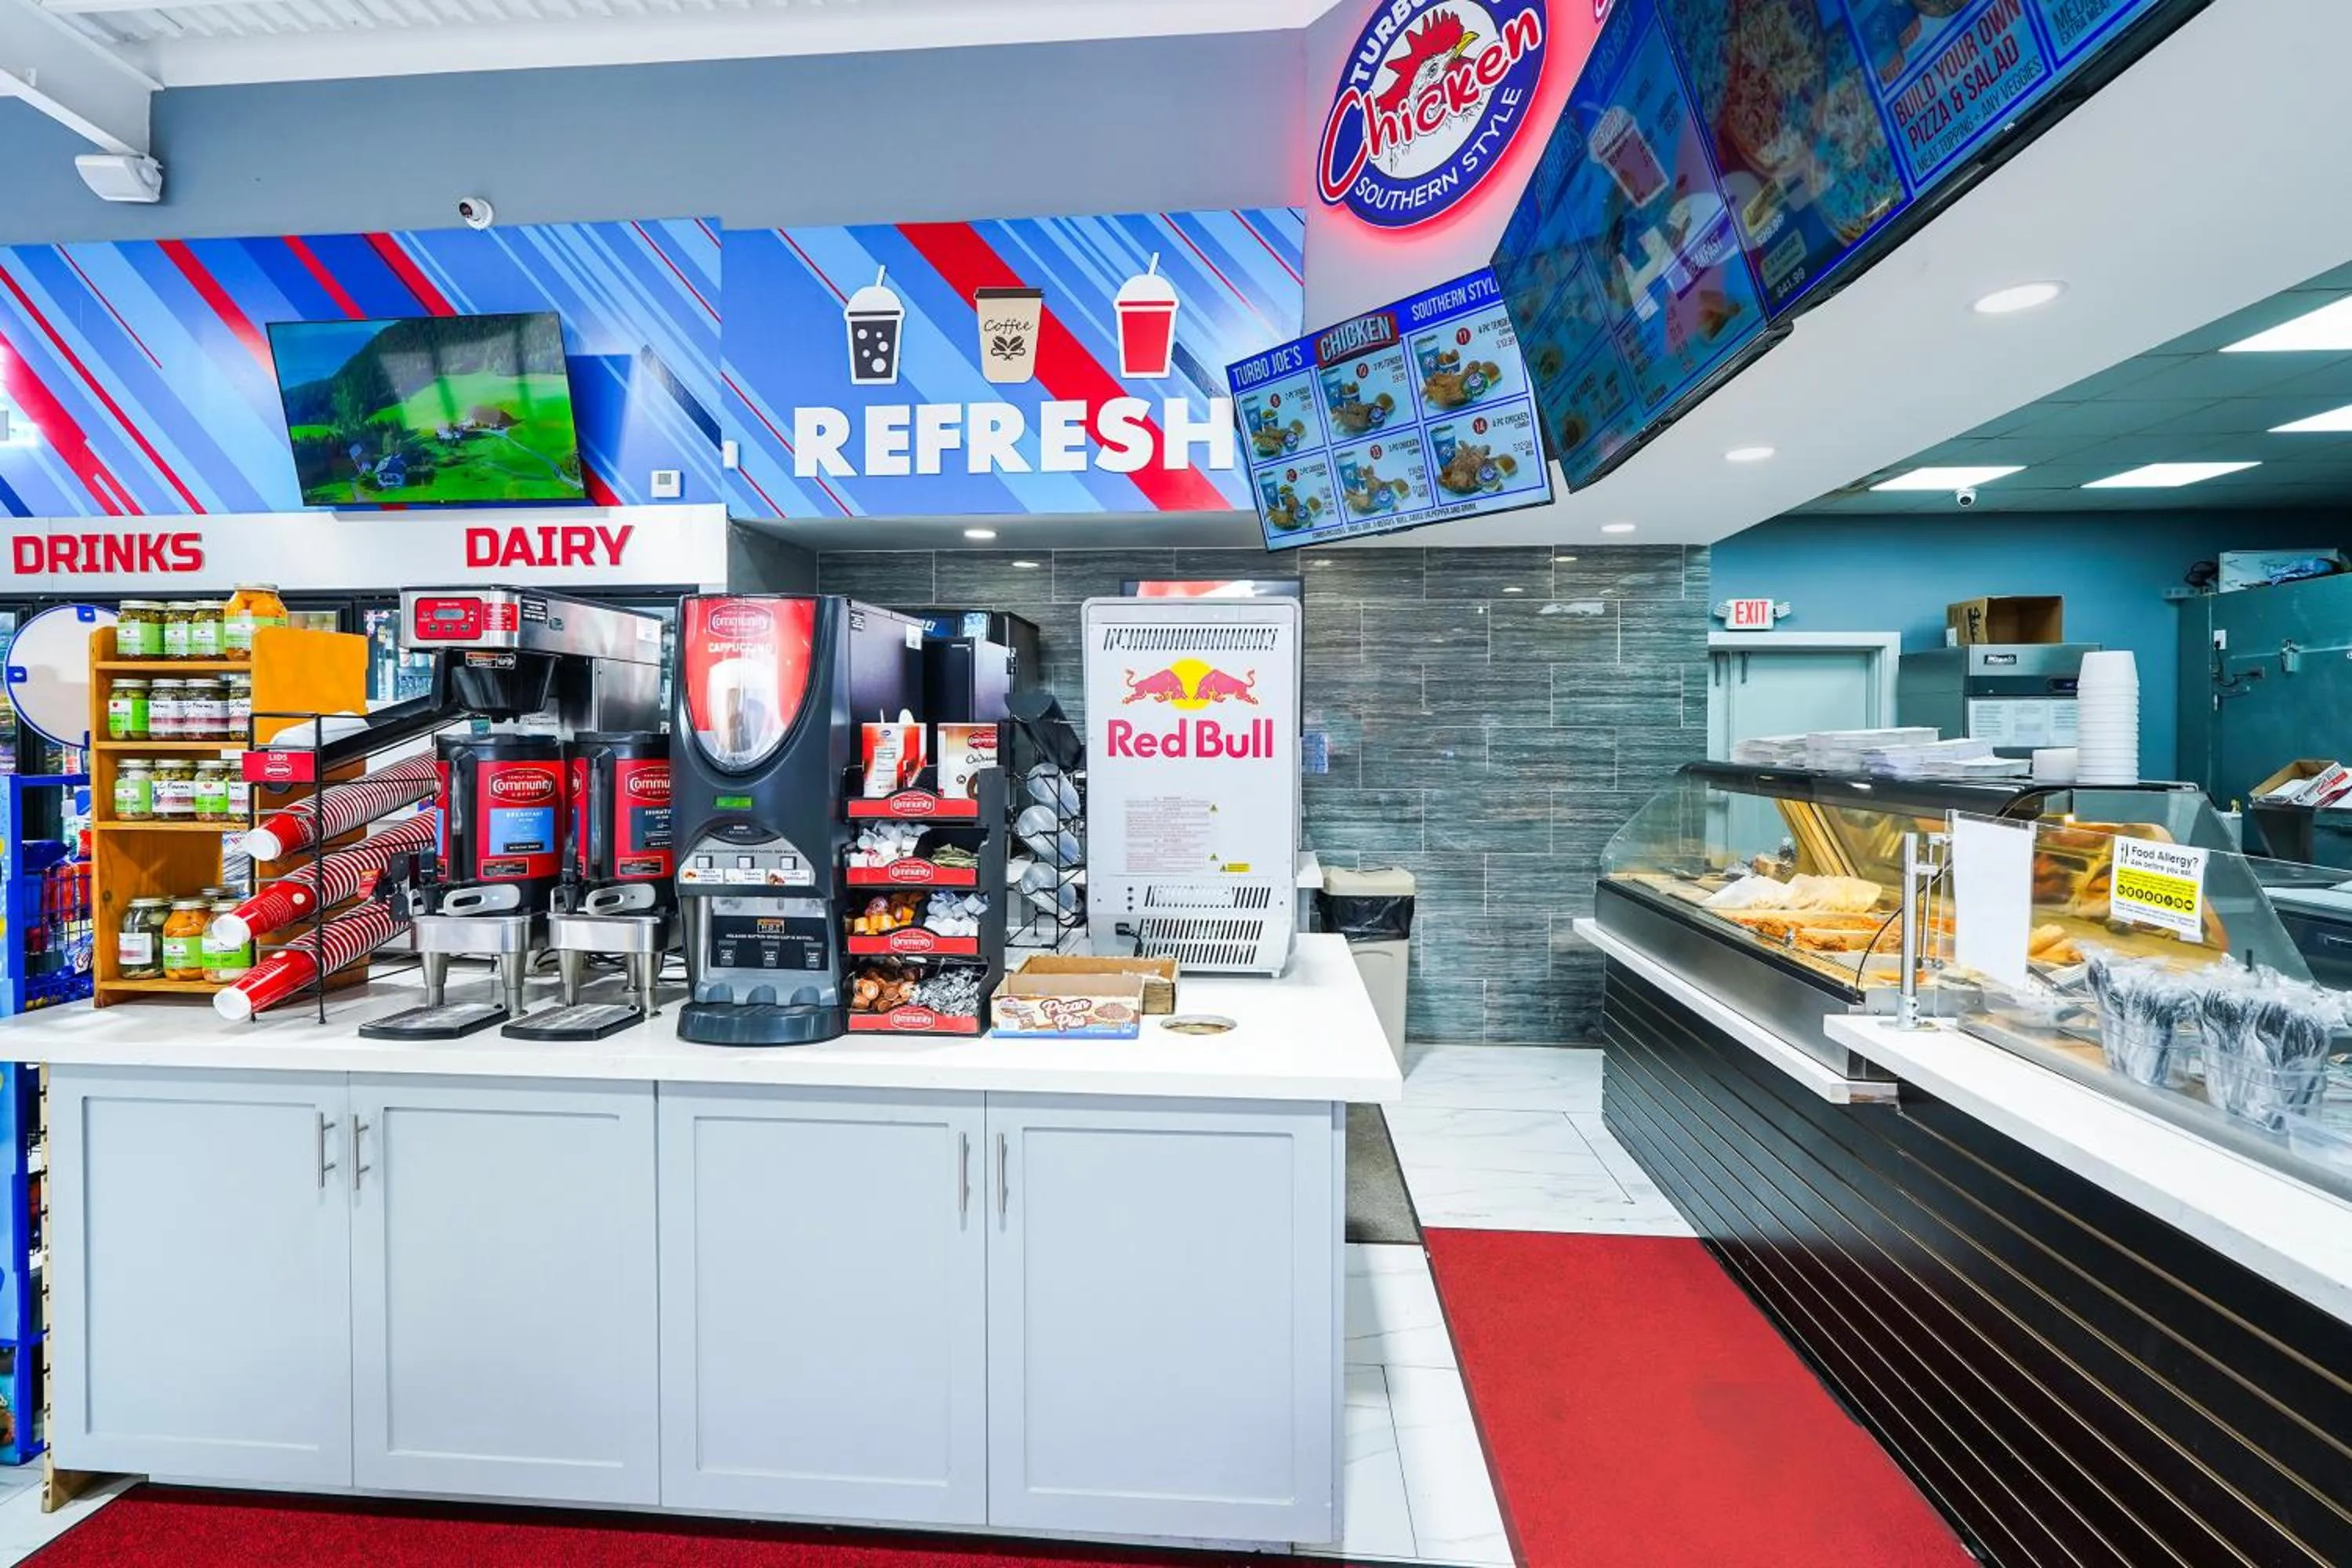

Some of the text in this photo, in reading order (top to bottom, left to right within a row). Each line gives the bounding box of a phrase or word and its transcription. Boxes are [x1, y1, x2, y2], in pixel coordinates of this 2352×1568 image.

[1350, 0, 1425, 84] TURB
[1893, 72, 1936, 126] BUILD
[1935, 31, 1979, 85] YOUR
[1976, 0, 2021, 45] OWN
[1319, 6, 1543, 202] Chicken
[1907, 100, 1951, 152] PIZZA
[1950, 88, 1965, 112] &
[1963, 34, 2020, 100] SALAD
[1356, 86, 1522, 211] SOUTHERN STYLE
[1918, 146, 1940, 171] MEAT
[1940, 118, 1974, 154] TOPPING
[1980, 95, 2000, 118] ANY
[984, 317, 1033, 335] Coffee
[1233, 356, 1271, 387] TURBO
[1271, 345, 1303, 378] JOE'S
[1319, 315, 1392, 361] CHICKEN
[1411, 287, 1466, 320] SOUTHERN
[793, 397, 1236, 478] REFRESH
[12, 524, 634, 575] DRINKS DAIRY
[710, 614, 768, 630] Community
[1735, 601, 1768, 625] EXIT
[268, 753, 288, 762] LIDS
[1107, 718, 1274, 758] Red Bull
[492, 778, 553, 794] Community
[2131, 847, 2200, 869] Food Allergy?
[1042, 1000, 1091, 1018] Pecan
